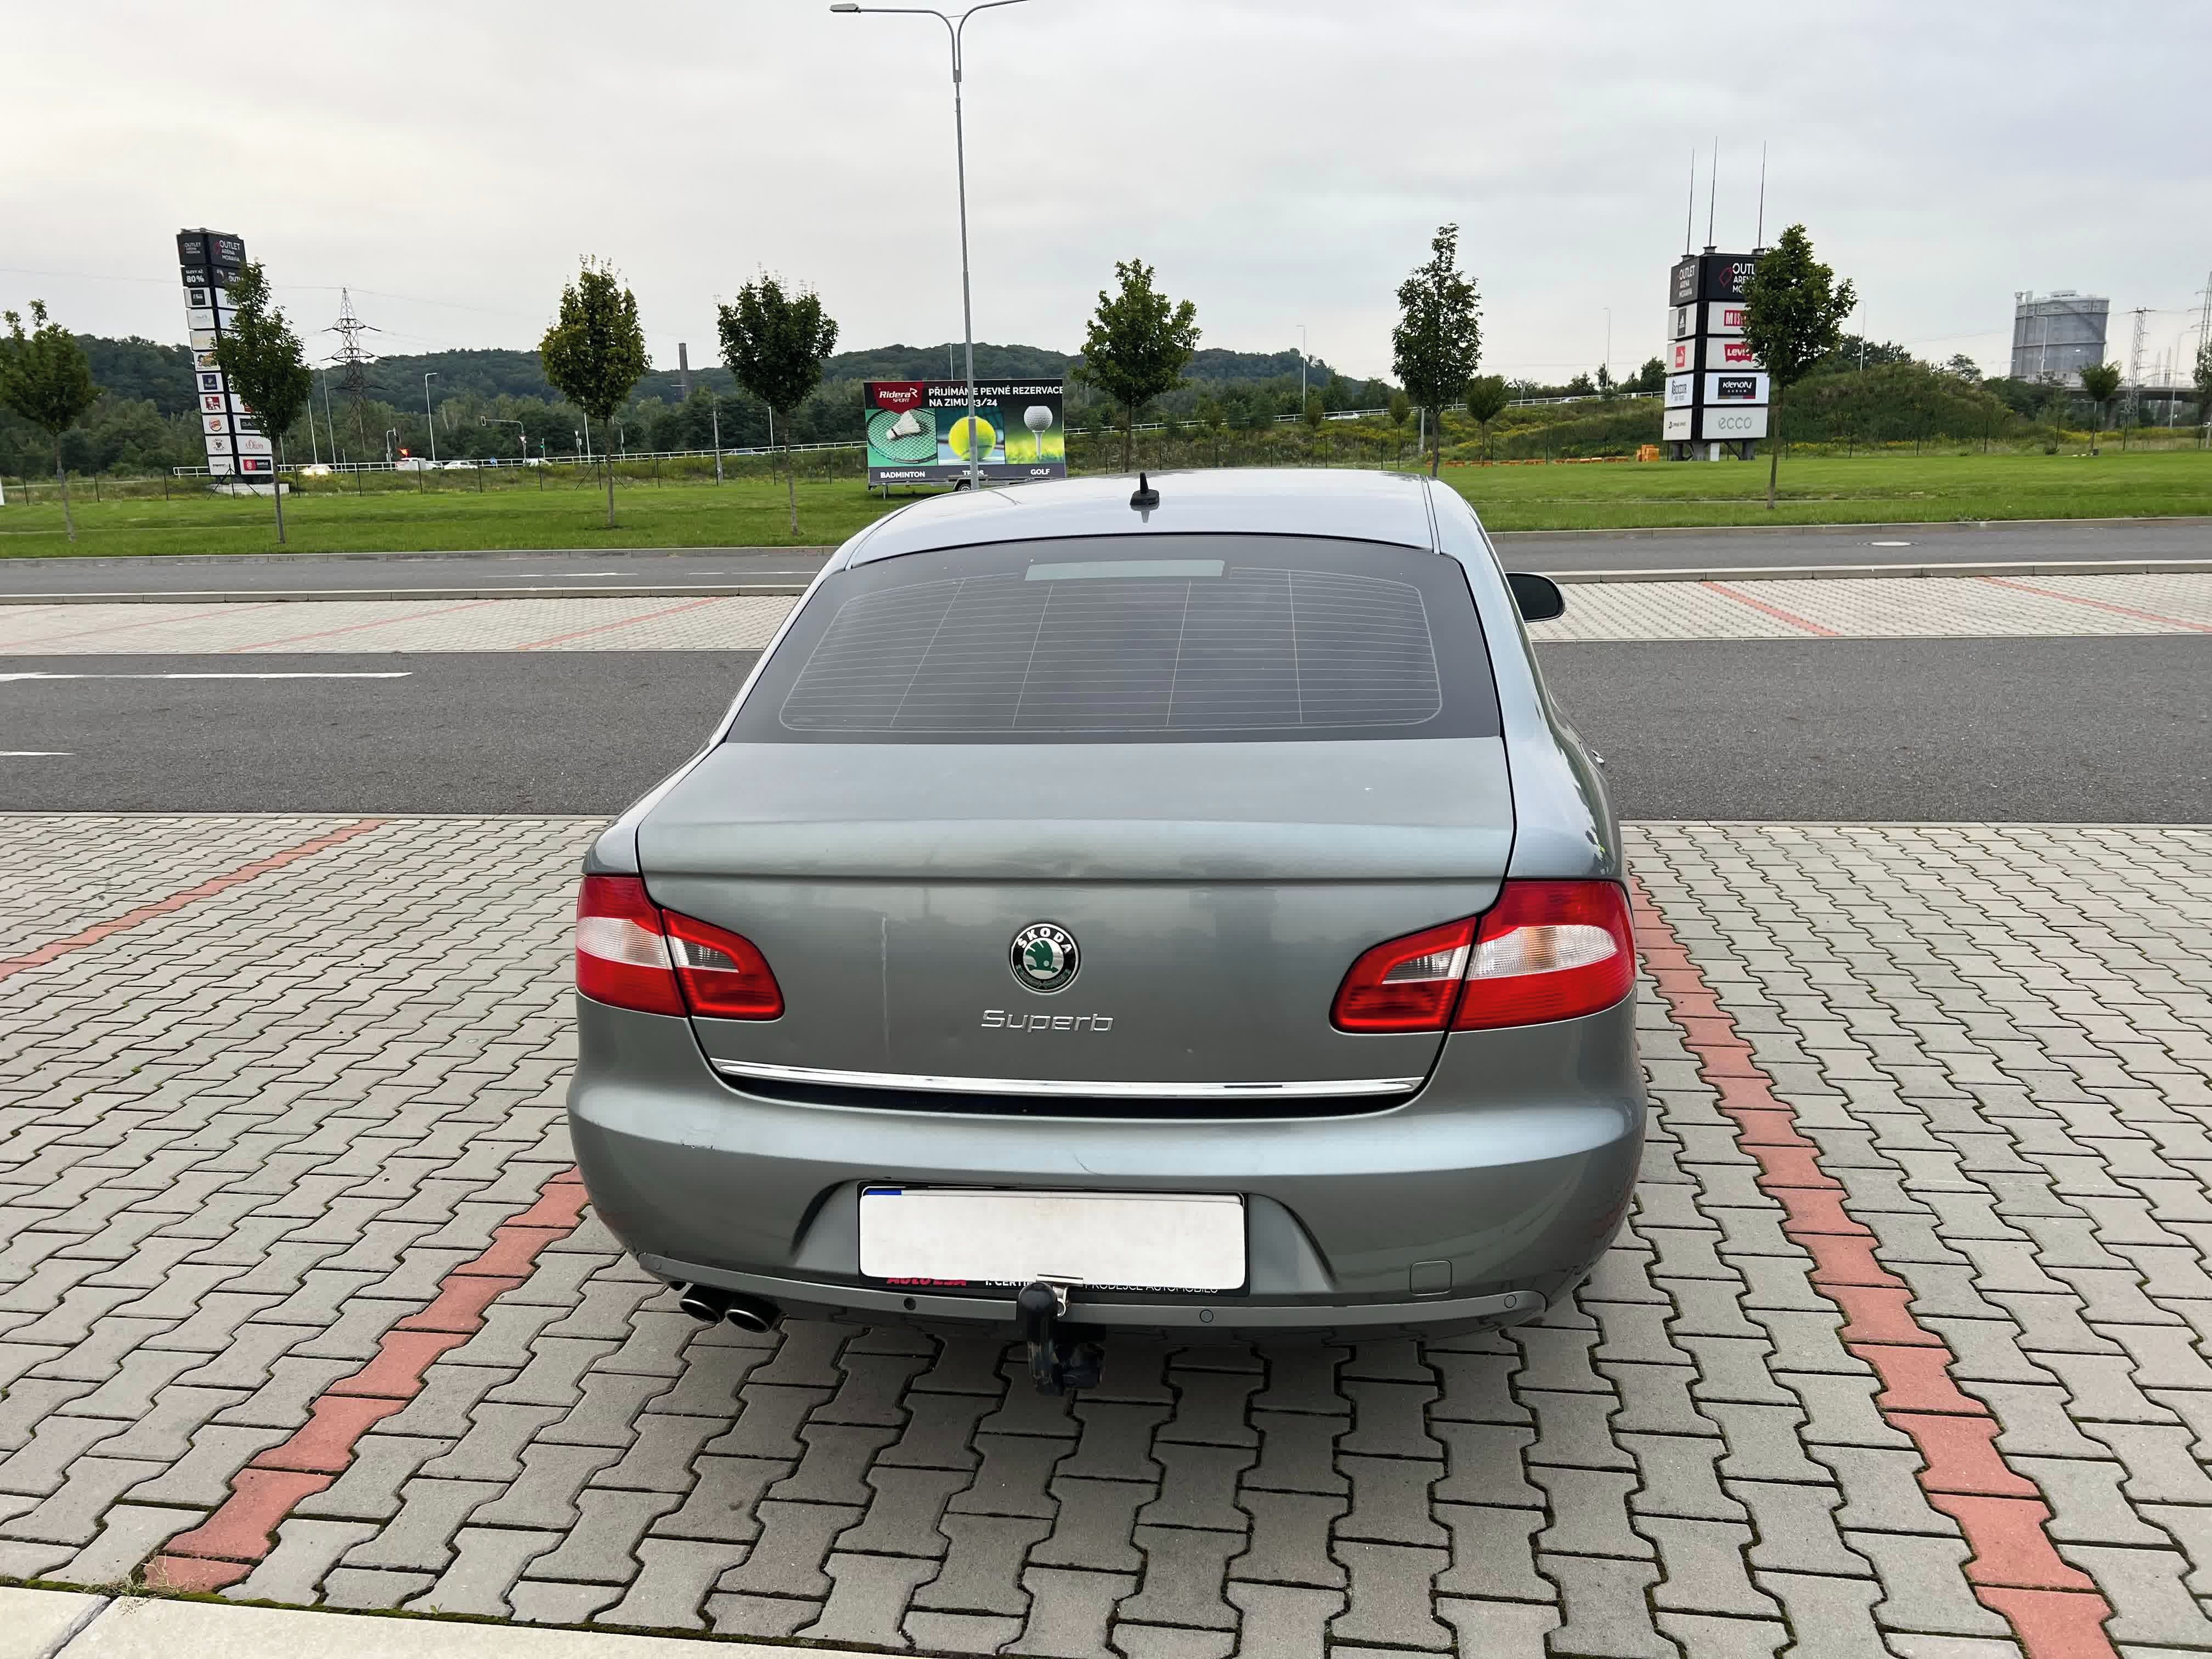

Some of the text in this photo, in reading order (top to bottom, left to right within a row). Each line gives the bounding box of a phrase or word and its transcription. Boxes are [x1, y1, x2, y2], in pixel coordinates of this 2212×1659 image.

[219, 240, 240, 251] OUTLET
[1679, 265, 1695, 280] OUTLET
[1733, 263, 1756, 274] OUTL
[879, 391, 911, 399] Ridera
[980, 385, 1011, 396] PEVNÉ
[1013, 386, 1063, 395] REZERVACE
[929, 398, 943, 407] NA
[945, 398, 968, 407] ZIMU
[1718, 416, 1752, 430] ecco
[880, 471, 926, 479] BADMINTON
[981, 1009, 1114, 1033] Superb
